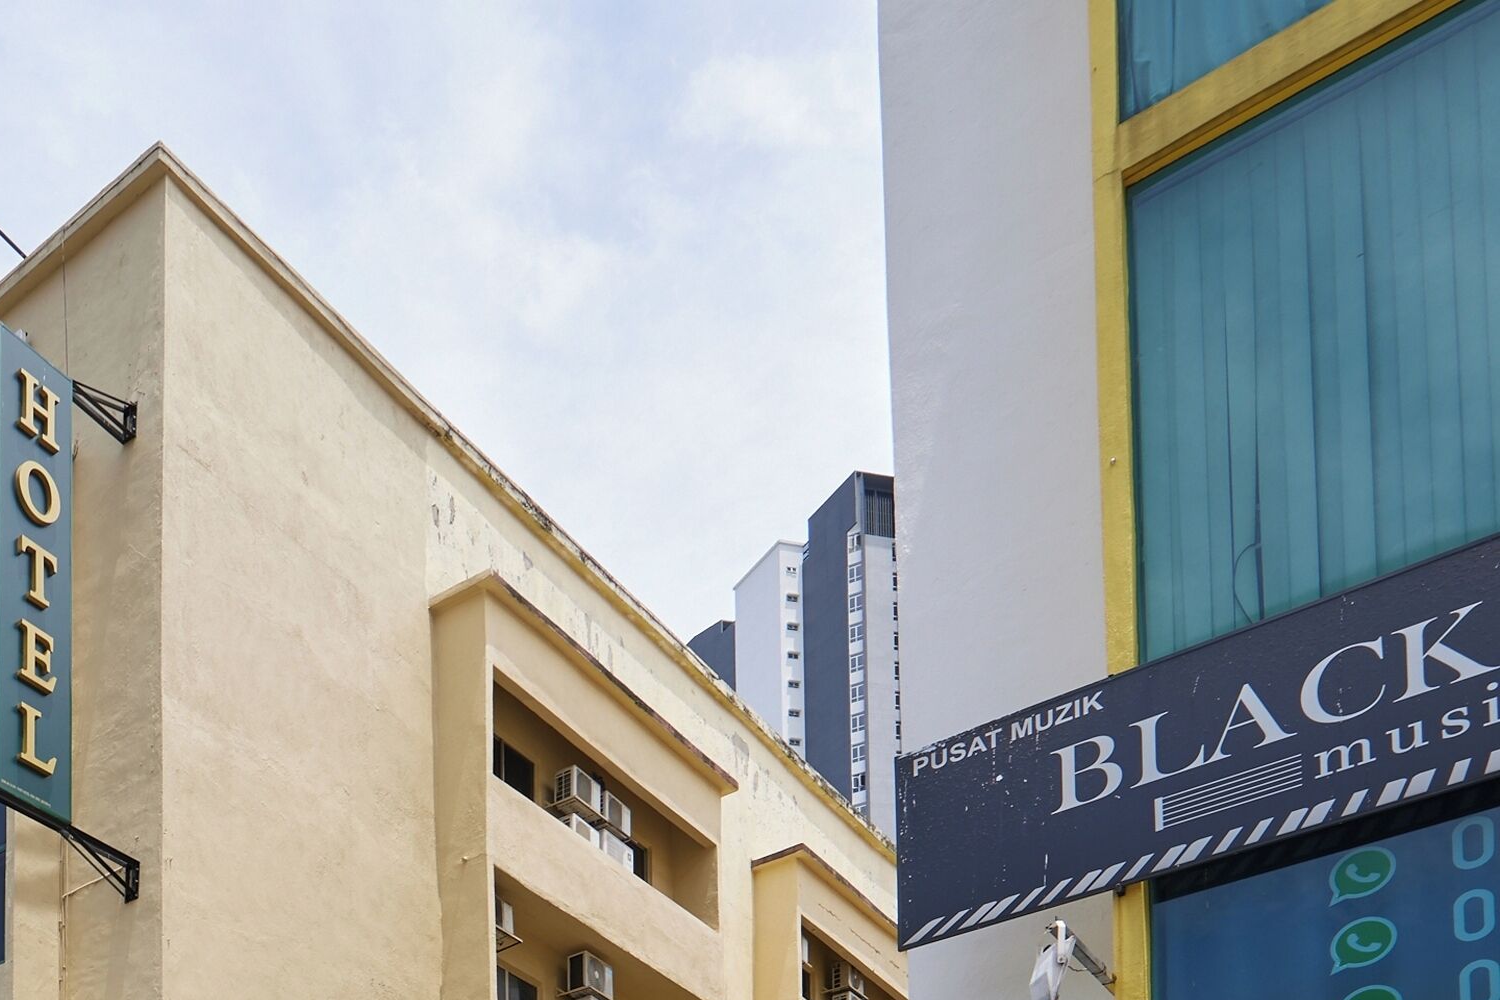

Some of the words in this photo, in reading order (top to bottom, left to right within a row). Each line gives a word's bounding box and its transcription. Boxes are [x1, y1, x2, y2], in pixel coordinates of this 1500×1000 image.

[15, 367, 62, 776] HOTEL
[912, 728, 1003, 777] PUSAT
[1011, 691, 1104, 741] MUZIK
[1050, 601, 1500, 815] BLACK
